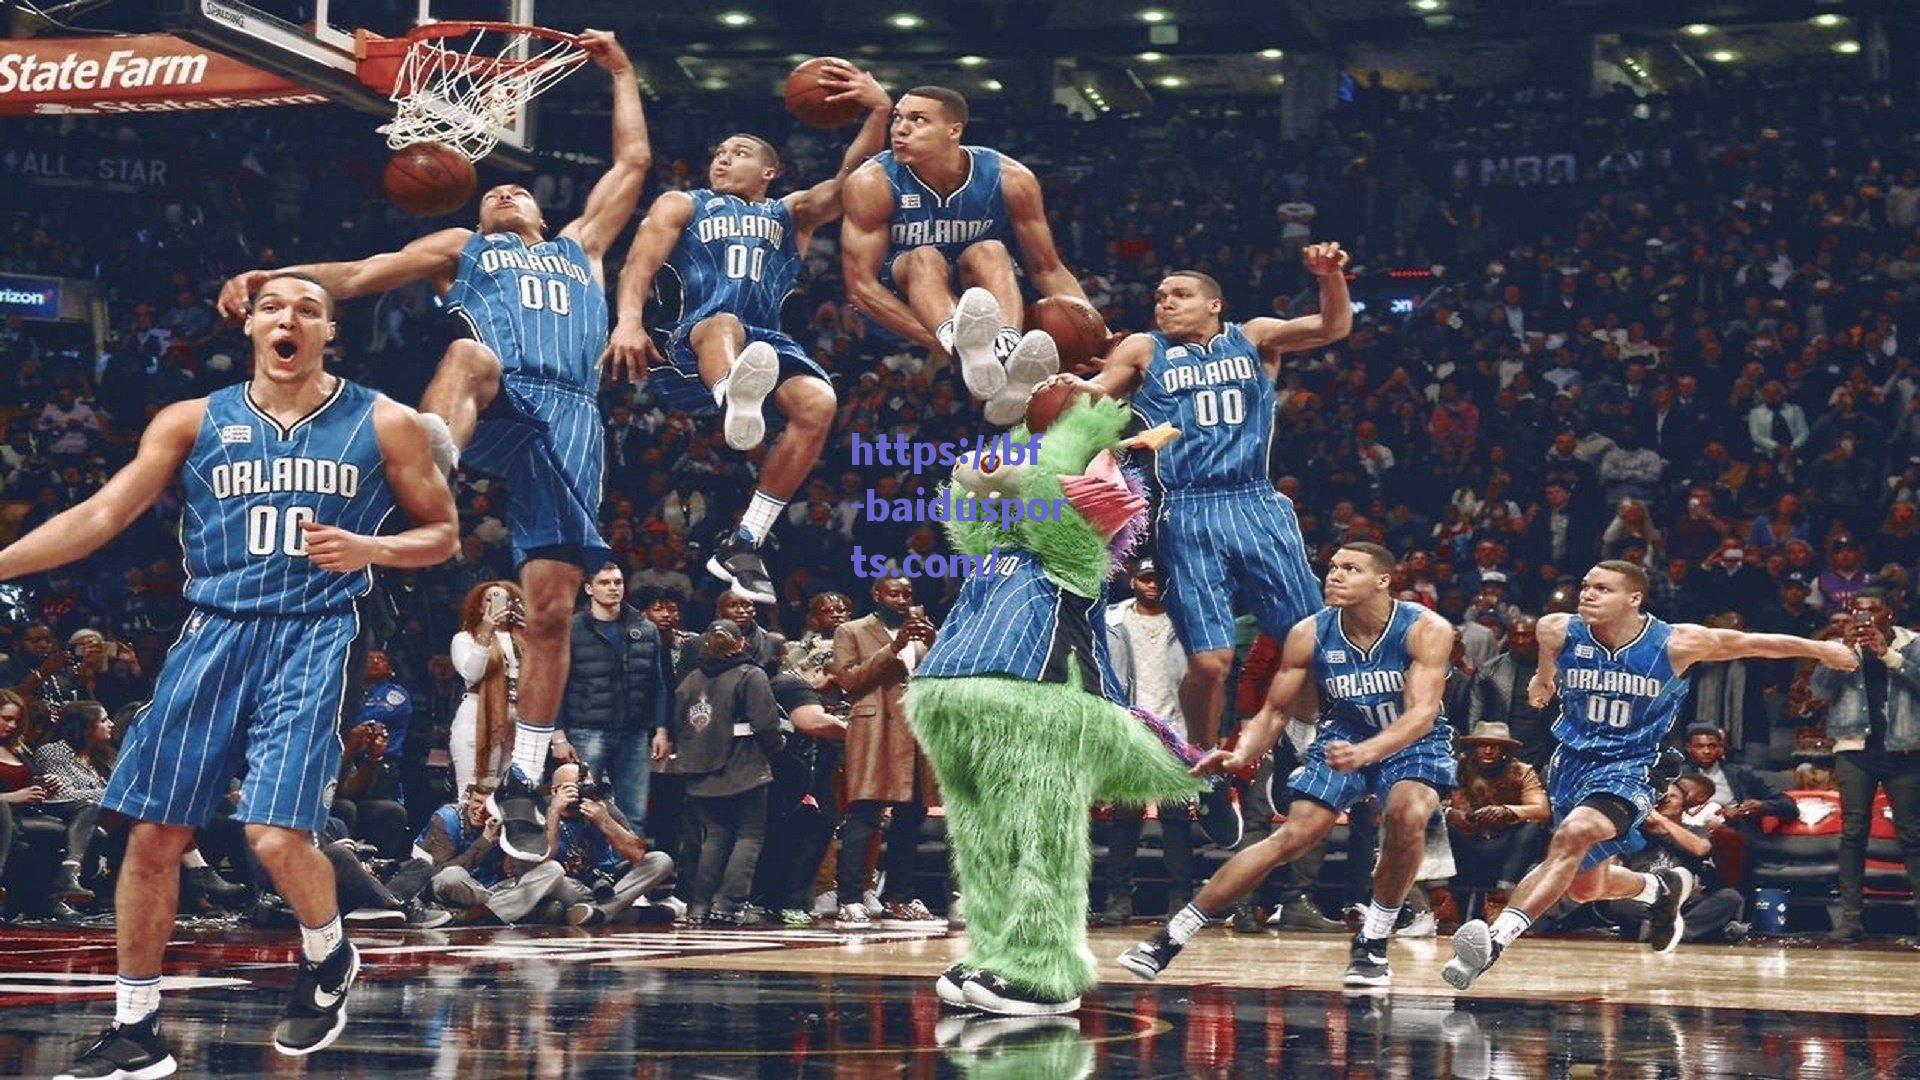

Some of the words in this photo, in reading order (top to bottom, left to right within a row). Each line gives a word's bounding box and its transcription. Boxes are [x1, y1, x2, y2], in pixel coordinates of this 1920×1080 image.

[0, 52, 99, 93] State
[100, 50, 208, 88] Farm
[23, 151, 71, 176] ALL
[98, 158, 167, 187] STAR
[699, 214, 784, 251] ORLANDO
[481, 248, 589, 287] ORLANDO
[727, 244, 765, 283] 00
[519, 274, 570, 316] 00
[1163, 355, 1255, 394] ORLAND
[1195, 388, 1246, 428] 00
[211, 457, 360, 500] ORLANDO
[248, 504, 315, 556] 00
[1325, 670, 1405, 699] ORLAND
[1566, 668, 1661, 698] ORLANDO
[1587, 694, 1631, 728] 00
